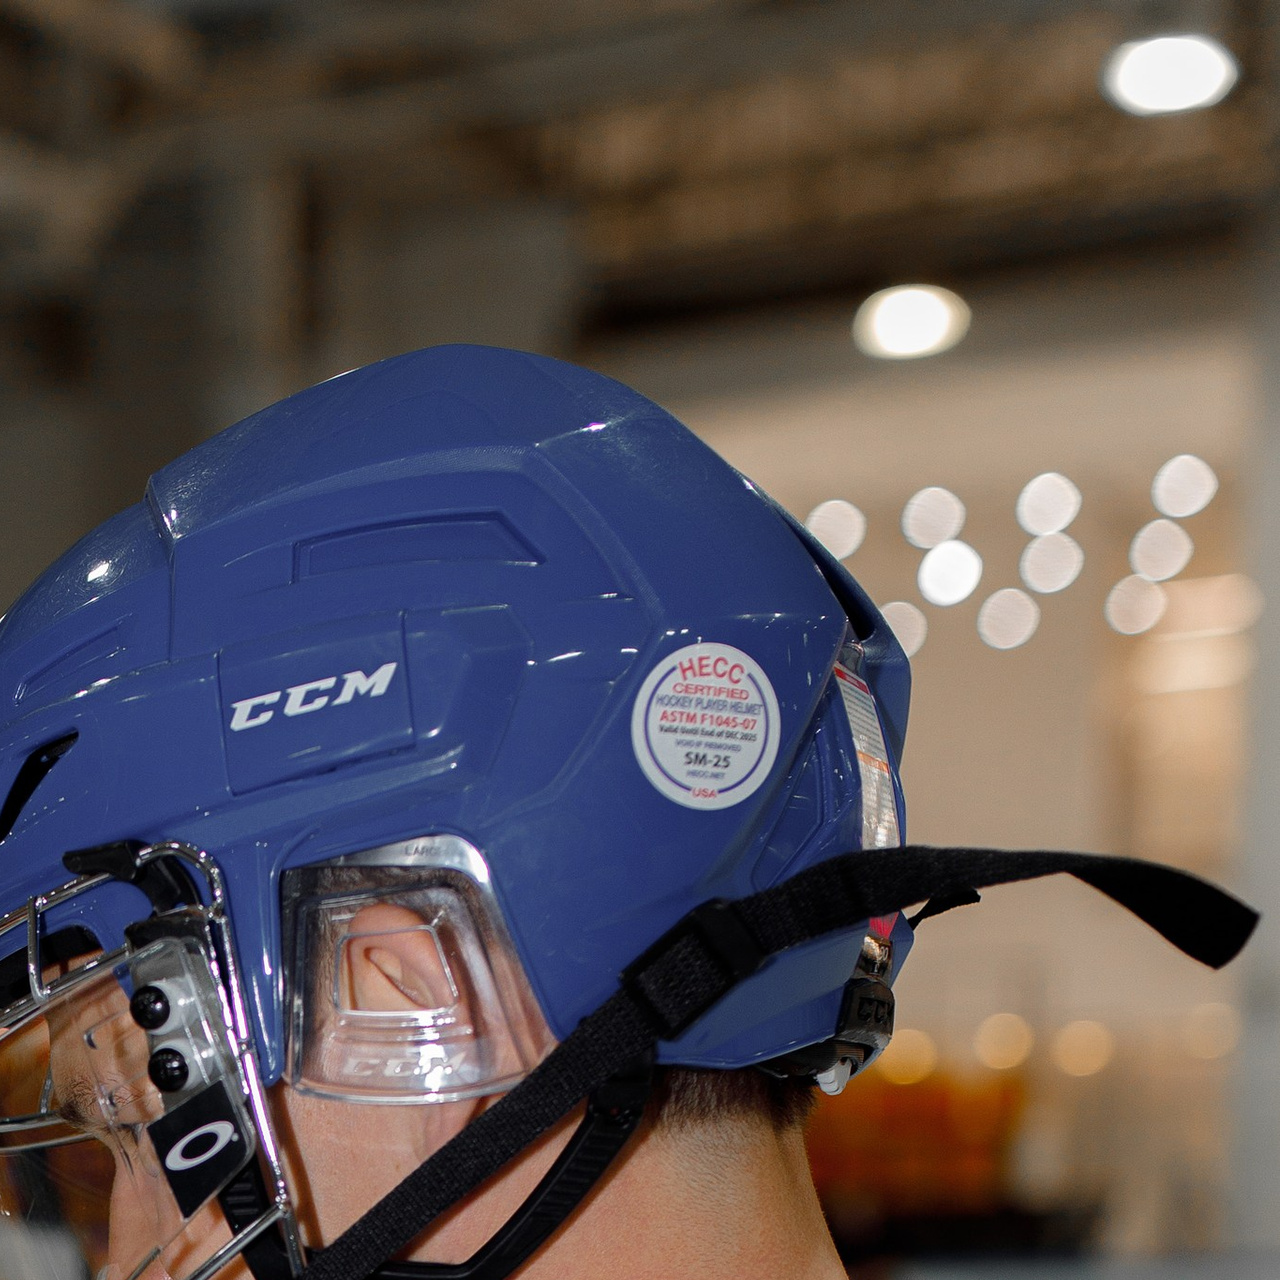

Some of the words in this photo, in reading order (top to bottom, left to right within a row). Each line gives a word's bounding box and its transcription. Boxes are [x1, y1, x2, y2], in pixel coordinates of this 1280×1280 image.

[677, 656, 745, 684] HECC
[230, 662, 398, 732] CCM
[672, 682, 750, 700] CERTIFIED
[656, 694, 693, 708] HOCKEY
[695, 697, 729, 711] PLAYER
[730, 701, 763, 715] HELMET
[659, 725, 679, 734] Valid
[660, 710, 697, 724] ASTM
[700, 713, 757, 730] F1045-07
[684, 751, 731, 769] SM-25
[692, 787, 717, 799] USA
